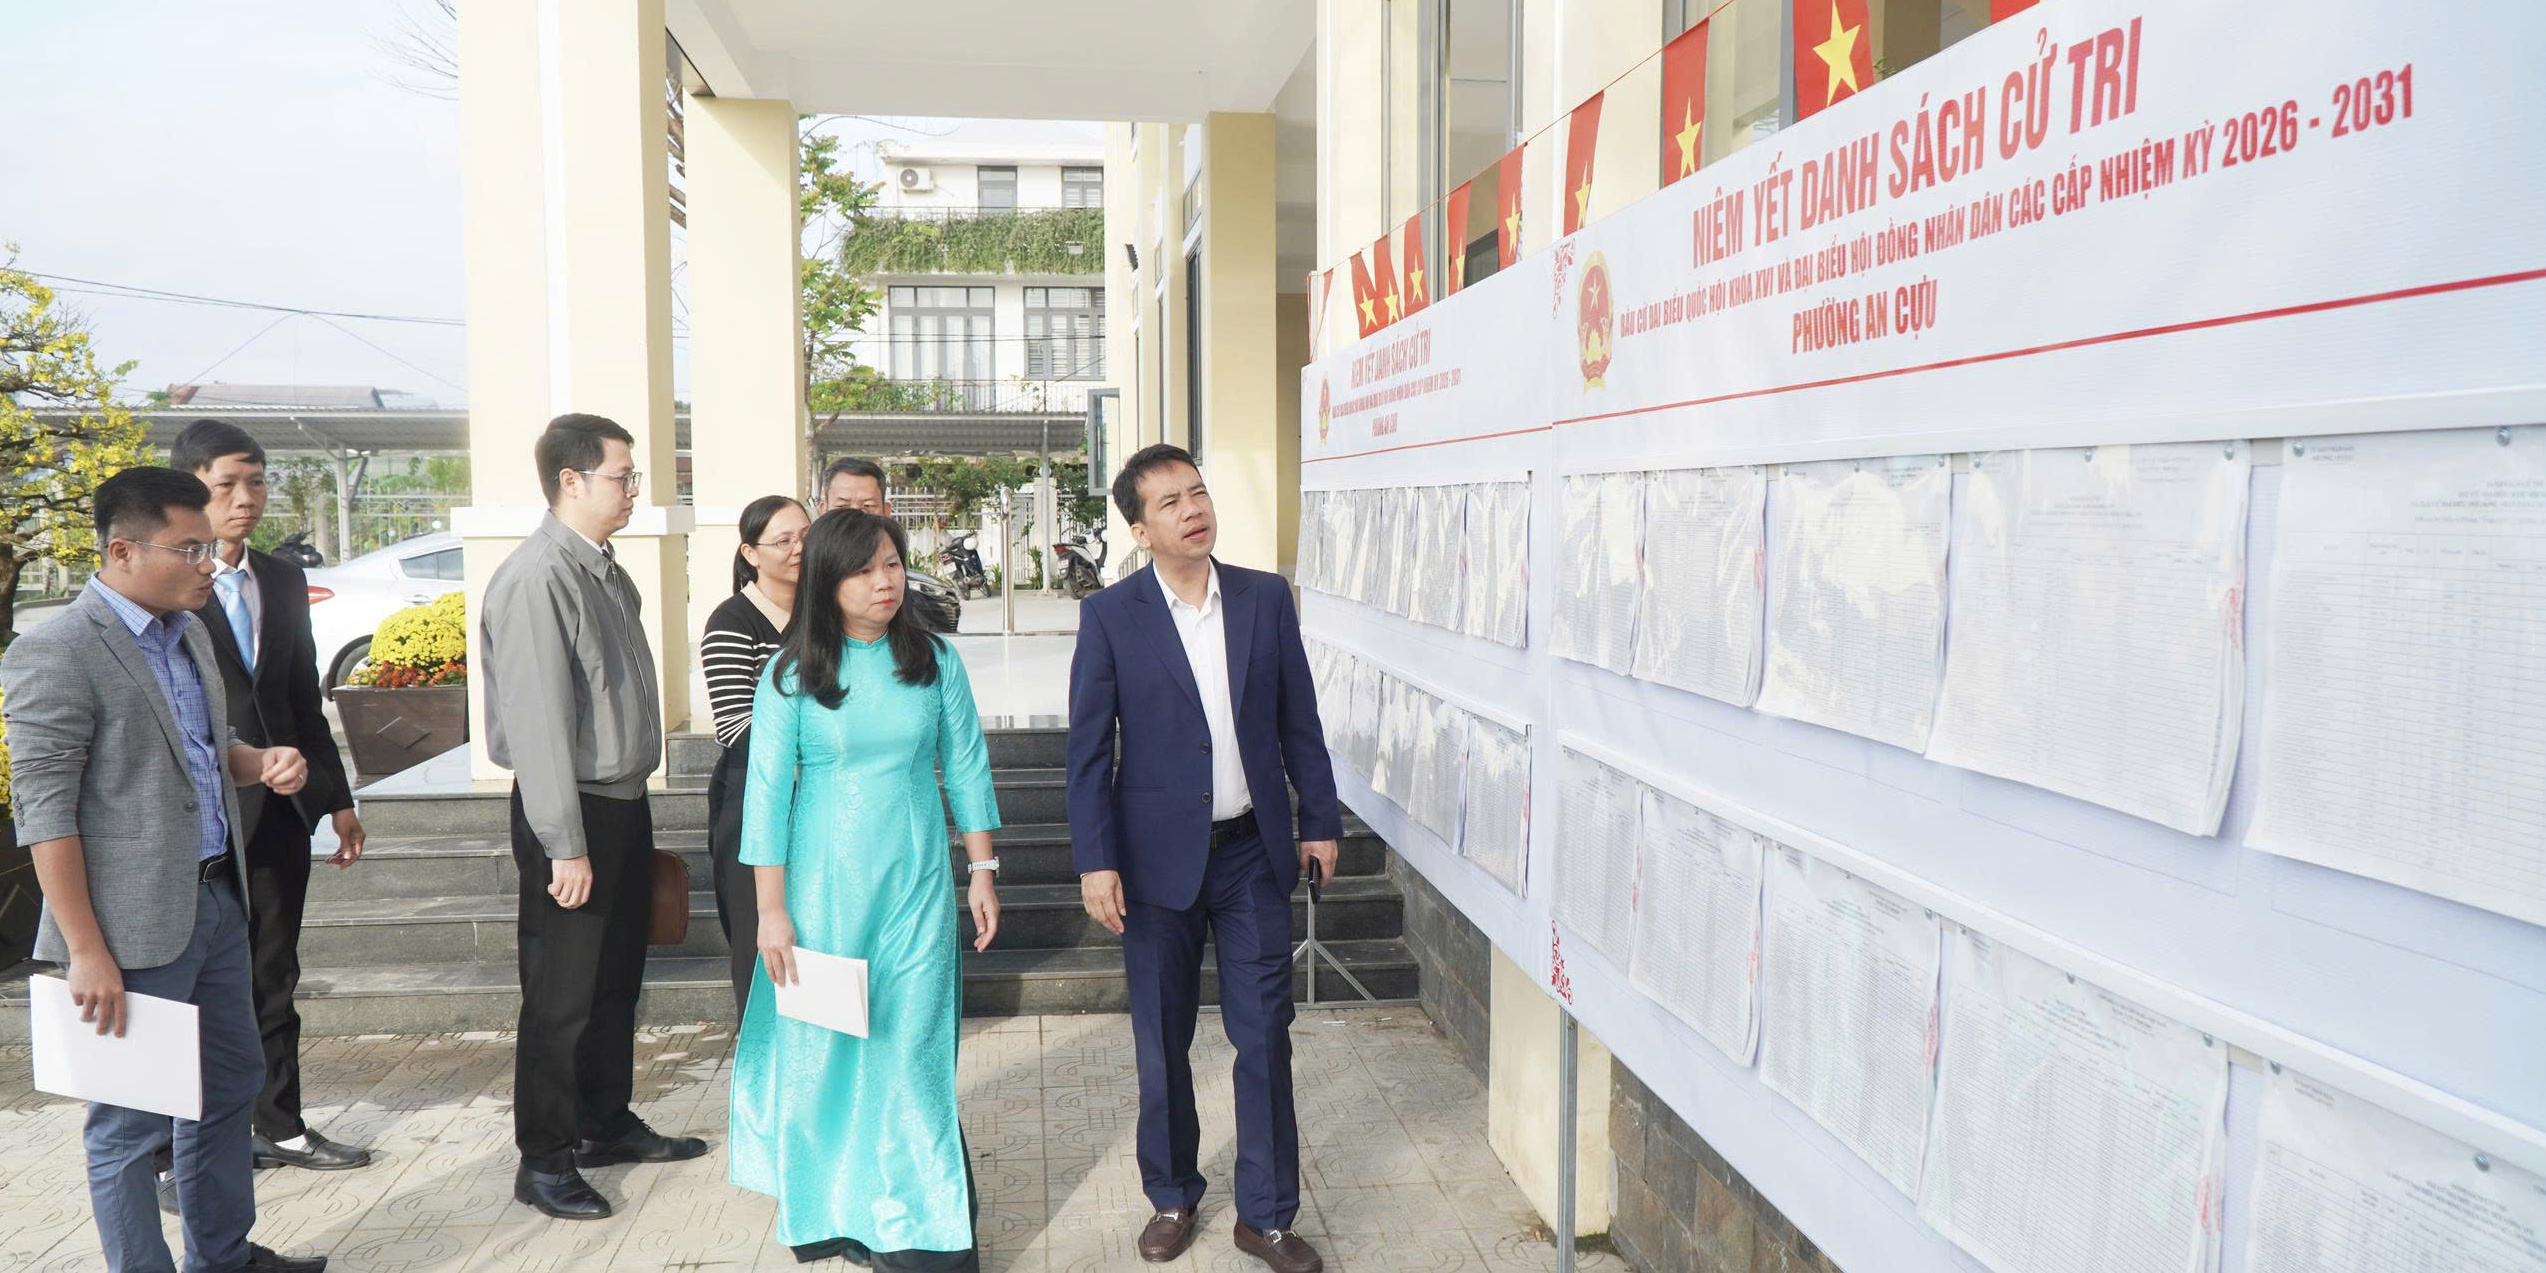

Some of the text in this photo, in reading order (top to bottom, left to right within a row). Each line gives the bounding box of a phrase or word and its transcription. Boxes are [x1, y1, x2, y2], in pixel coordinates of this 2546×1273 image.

[1692, 16, 2143, 268] NIÊM YẾT DANH SÁCH CỬ TRI
[1756, 267, 1774, 300] XVI
[1777, 257, 1792, 294] VÀ
[1794, 253, 1813, 293] ĐẠI
[1816, 234, 1847, 283] BIỂU
[1851, 231, 1873, 277] HỘI
[1876, 217, 1919, 267] ĐỒNG
[1925, 202, 1966, 254] NHÂN
[1969, 190, 2004, 240] DÂN
[2007, 177, 2048, 227] CÁC
[2052, 154, 2093, 216] CẤP
[2100, 138, 2176, 203] NHIỆM
[2182, 120, 2216, 180] KỲ
[2223, 99, 2299, 168] 2026
[2308, 117, 2321, 129] -
[2331, 63, 2414, 139] 2031
[1792, 275, 1939, 354] PHƯỜNG AN CỰU
